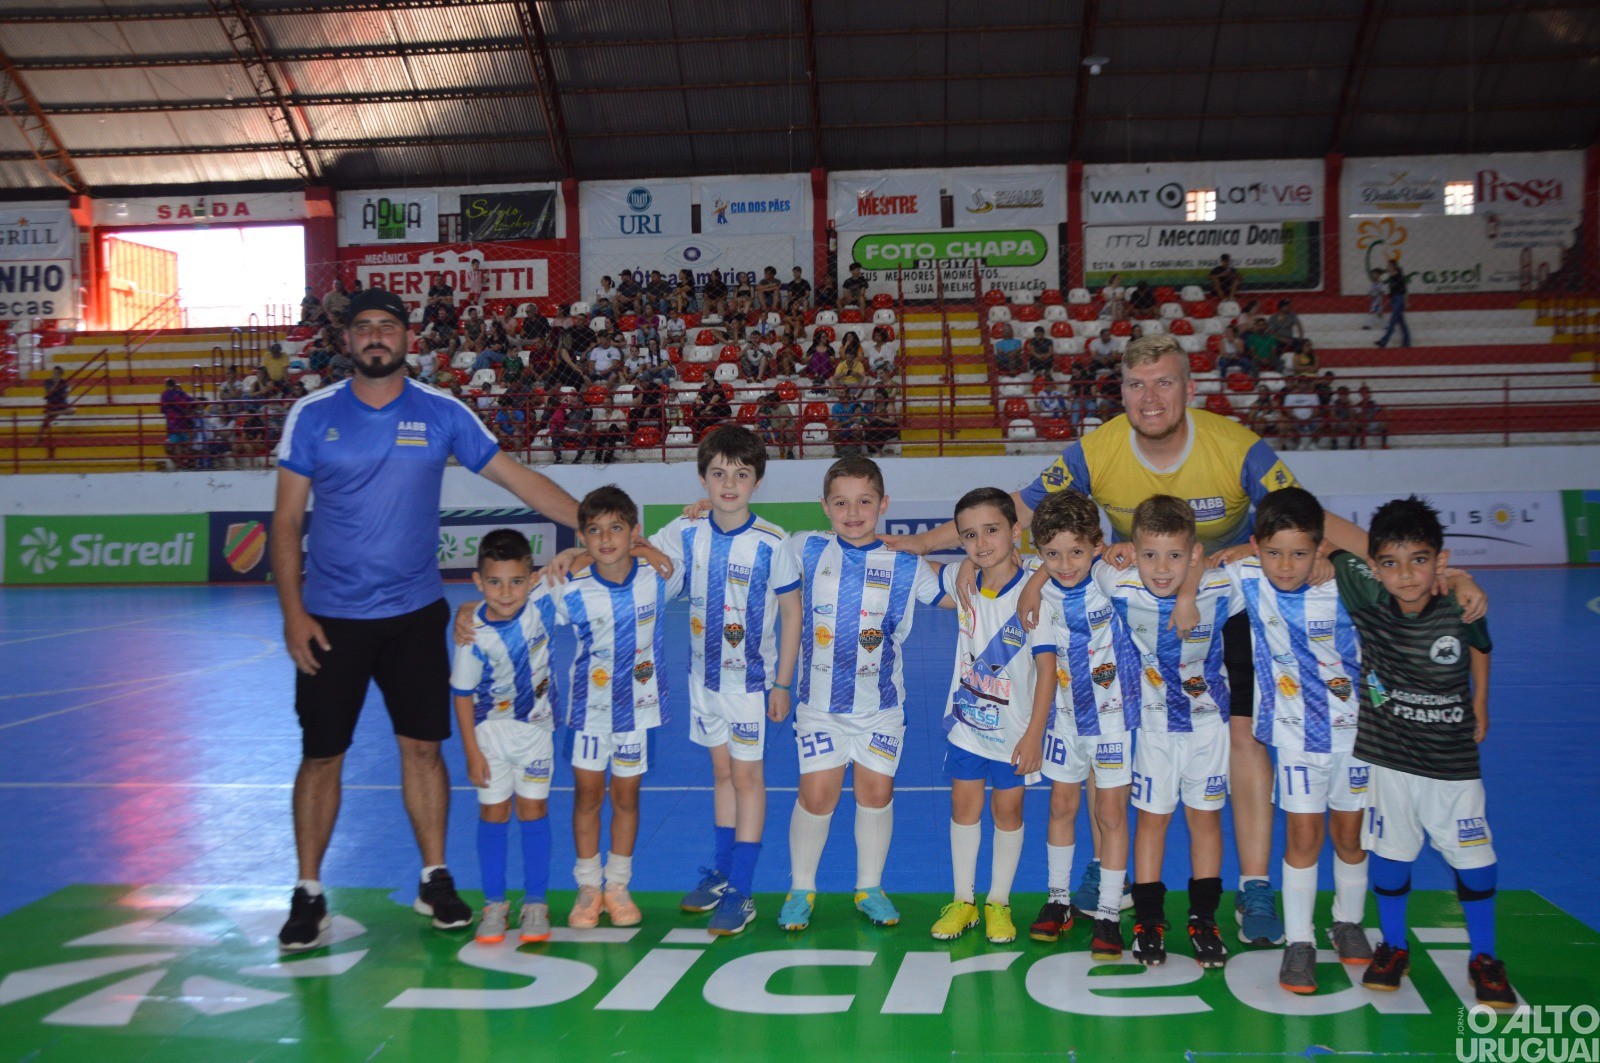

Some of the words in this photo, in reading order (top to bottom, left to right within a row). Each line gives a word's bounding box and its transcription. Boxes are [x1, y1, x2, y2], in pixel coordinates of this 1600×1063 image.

[731, 202, 747, 213] CIA
[749, 201, 766, 213] DOS
[768, 199, 791, 212] PÃES
[857, 195, 918, 216] MESTRE
[618, 214, 662, 235] URI
[364, 251, 408, 264] MECÂNICA
[866, 243, 936, 260] FOTO
[946, 240, 1036, 258] CHAPA
[918, 257, 987, 269] DIGITAL
[369, 267, 534, 295] BERTOLTTI
[885, 270, 935, 282] MEHORES
[397, 421, 427, 431] AABB
[1189, 497, 1224, 511] AABB
[68, 532, 196, 567] Sicredi
[729, 564, 750, 575] AABB
[867, 569, 891, 579] AABB
[1089, 605, 1112, 620] AABB
[800, 732, 834, 758] 55
[874, 733, 900, 746] AABB
[582, 735, 599, 760] 11
[1045, 734, 1067, 765] 18
[1097, 743, 1123, 754] AABB
[1283, 766, 1311, 796] 17
[382, 926, 1535, 1015] Sicredi
